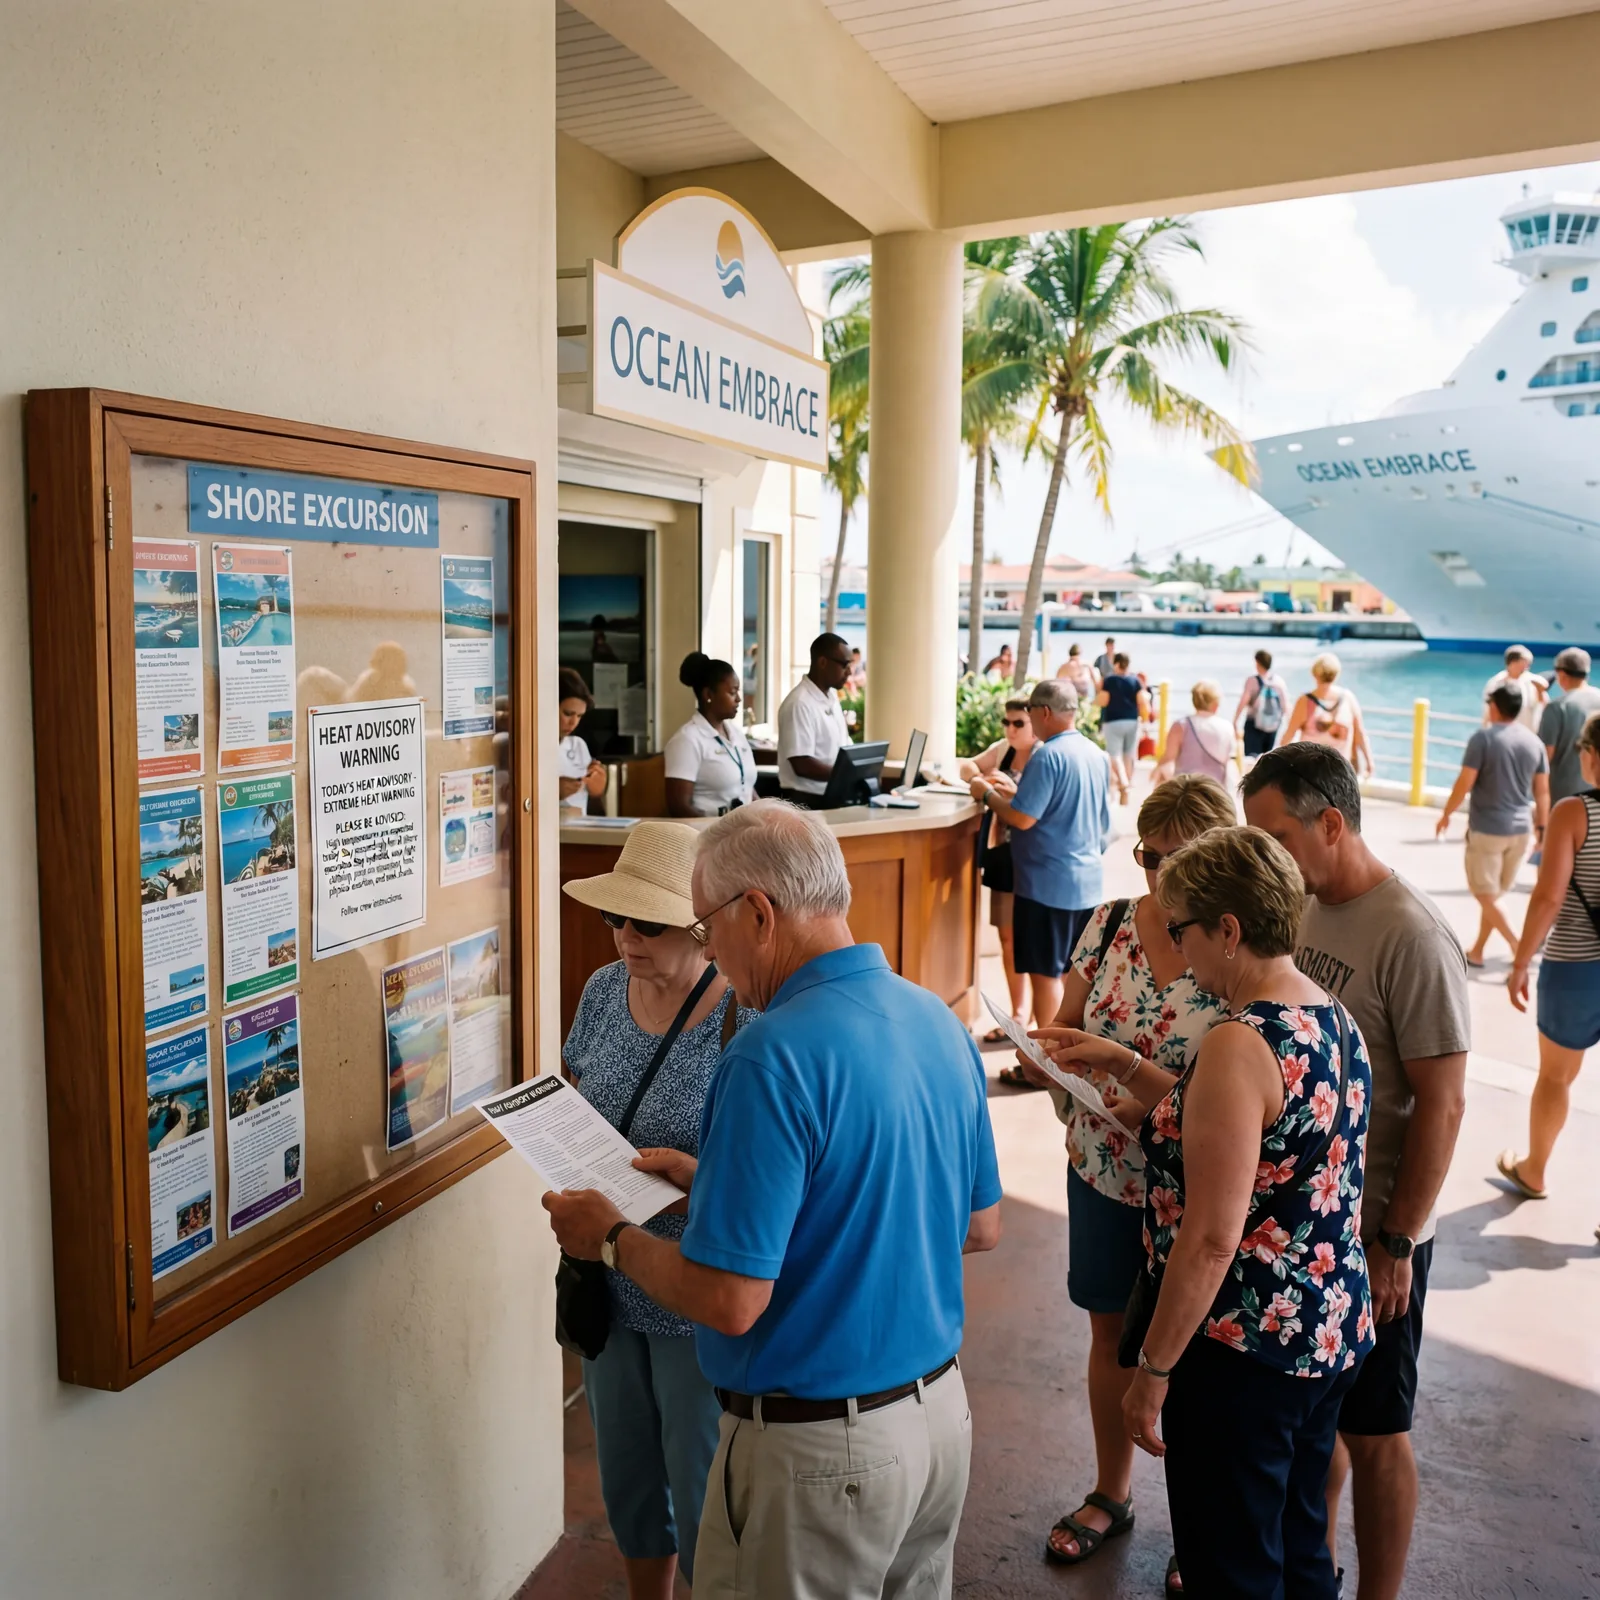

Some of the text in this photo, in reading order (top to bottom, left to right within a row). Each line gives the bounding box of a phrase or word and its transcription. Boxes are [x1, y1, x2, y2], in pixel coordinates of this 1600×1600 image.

[610, 315, 819, 438] OCEAN EMBRACE
[1296, 449, 1477, 483] OCEAN EMBRACE
[206, 482, 428, 535] SHORE EXCURSION
[319, 717, 416, 746] HEAT ADVISORY
[340, 744, 400, 769] WARNING
[321, 781, 355, 798] TODAY'S
[356, 778, 375, 792] HEAT
[376, 772, 413, 789] ADVISORY
[360, 793, 380, 807] HEAT
[380, 786, 415, 803] WARNING
[335, 818, 363, 835] PLEASE
